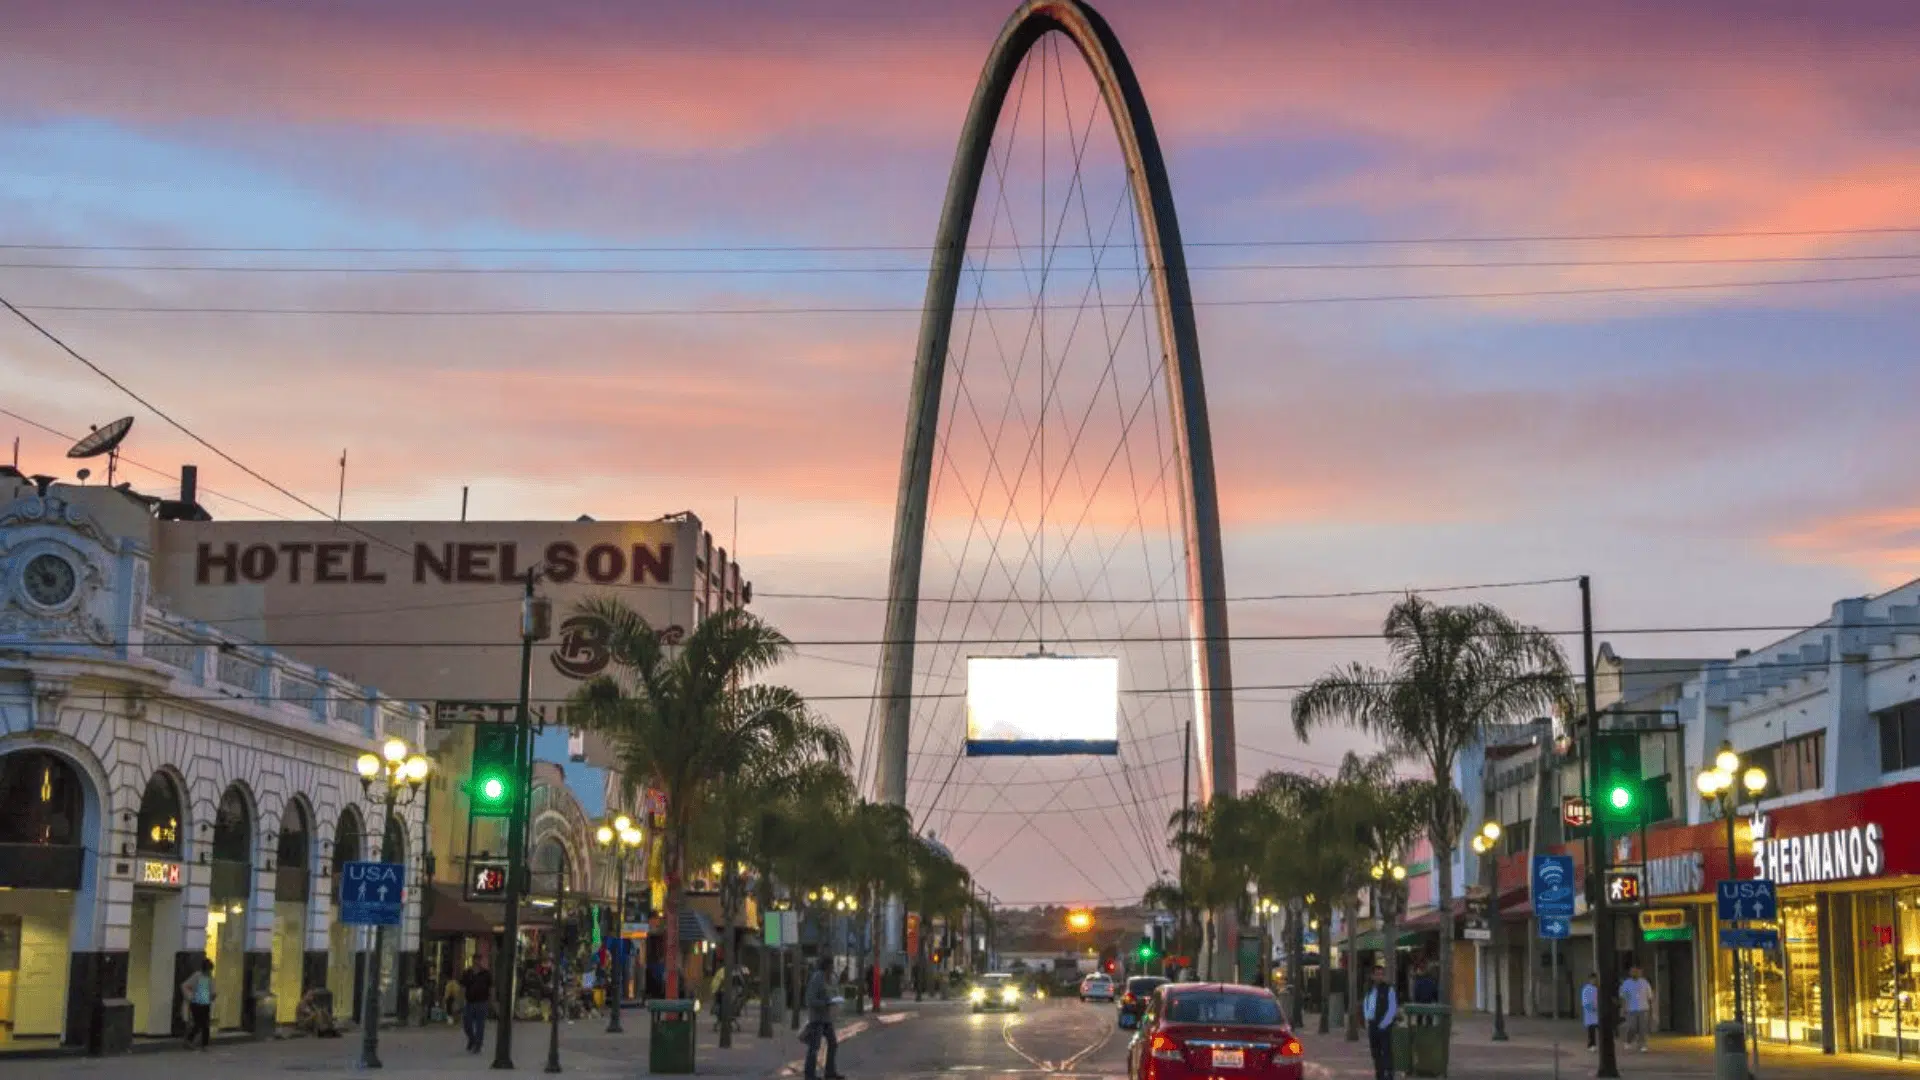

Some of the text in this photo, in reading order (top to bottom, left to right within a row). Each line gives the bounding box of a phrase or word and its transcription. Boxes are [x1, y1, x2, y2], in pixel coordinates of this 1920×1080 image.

[196, 540, 674, 585] HOTEL NELSON
[1767, 822, 1880, 885] HERMANOS
[349, 865, 397, 883] USA
[1622, 879, 1638, 898] 21
[1722, 882, 1771, 899] USA
